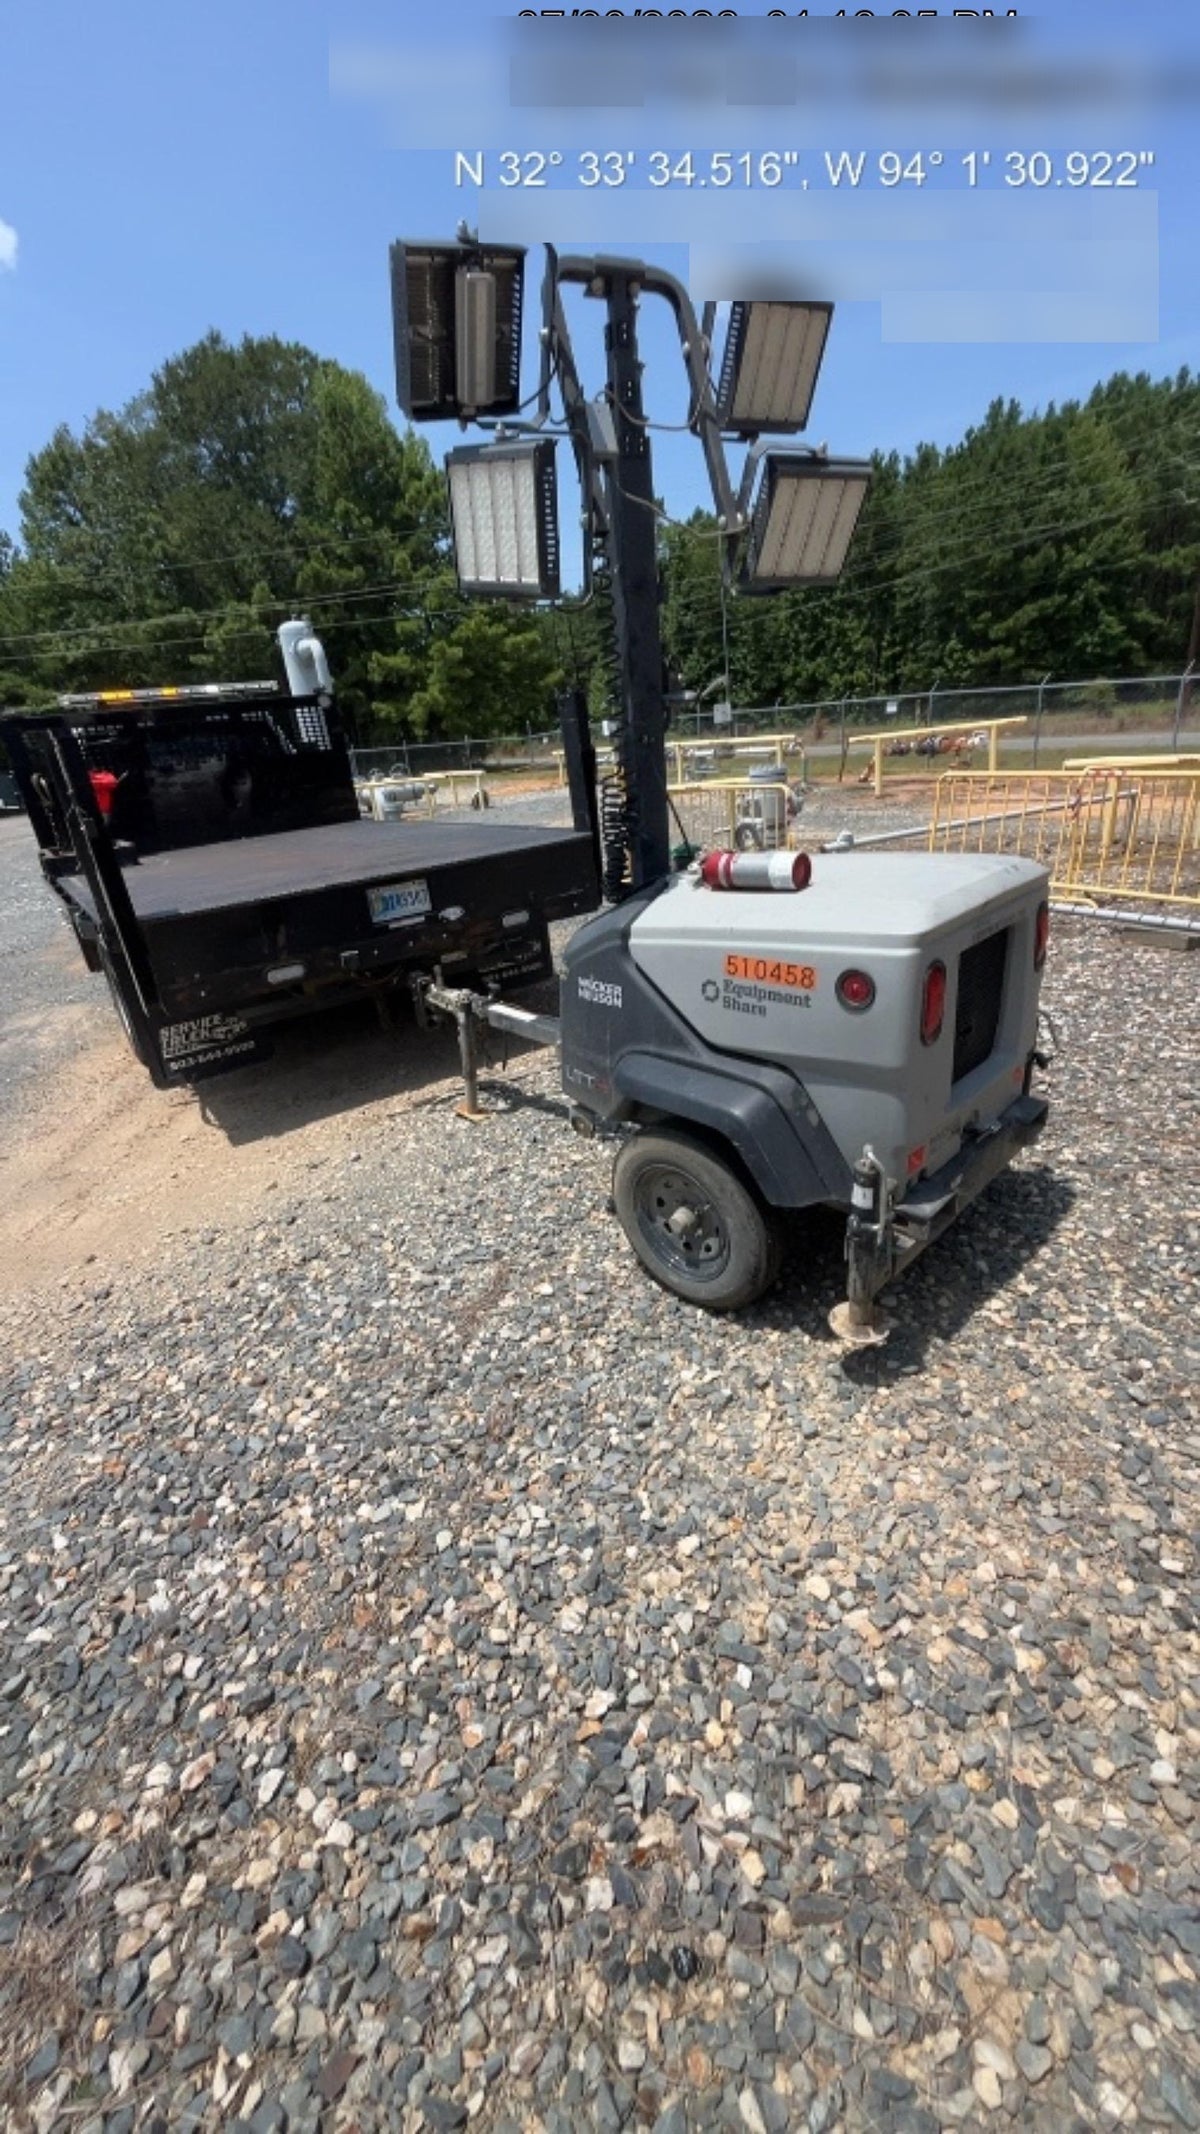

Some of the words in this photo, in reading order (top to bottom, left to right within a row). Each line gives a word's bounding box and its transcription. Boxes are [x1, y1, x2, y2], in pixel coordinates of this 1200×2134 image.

[726, 955, 815, 989] 510458
[722, 979, 813, 1009] Equipment
[722, 995, 768, 1017] Share
[160, 1013, 222, 1040] SERVICE
